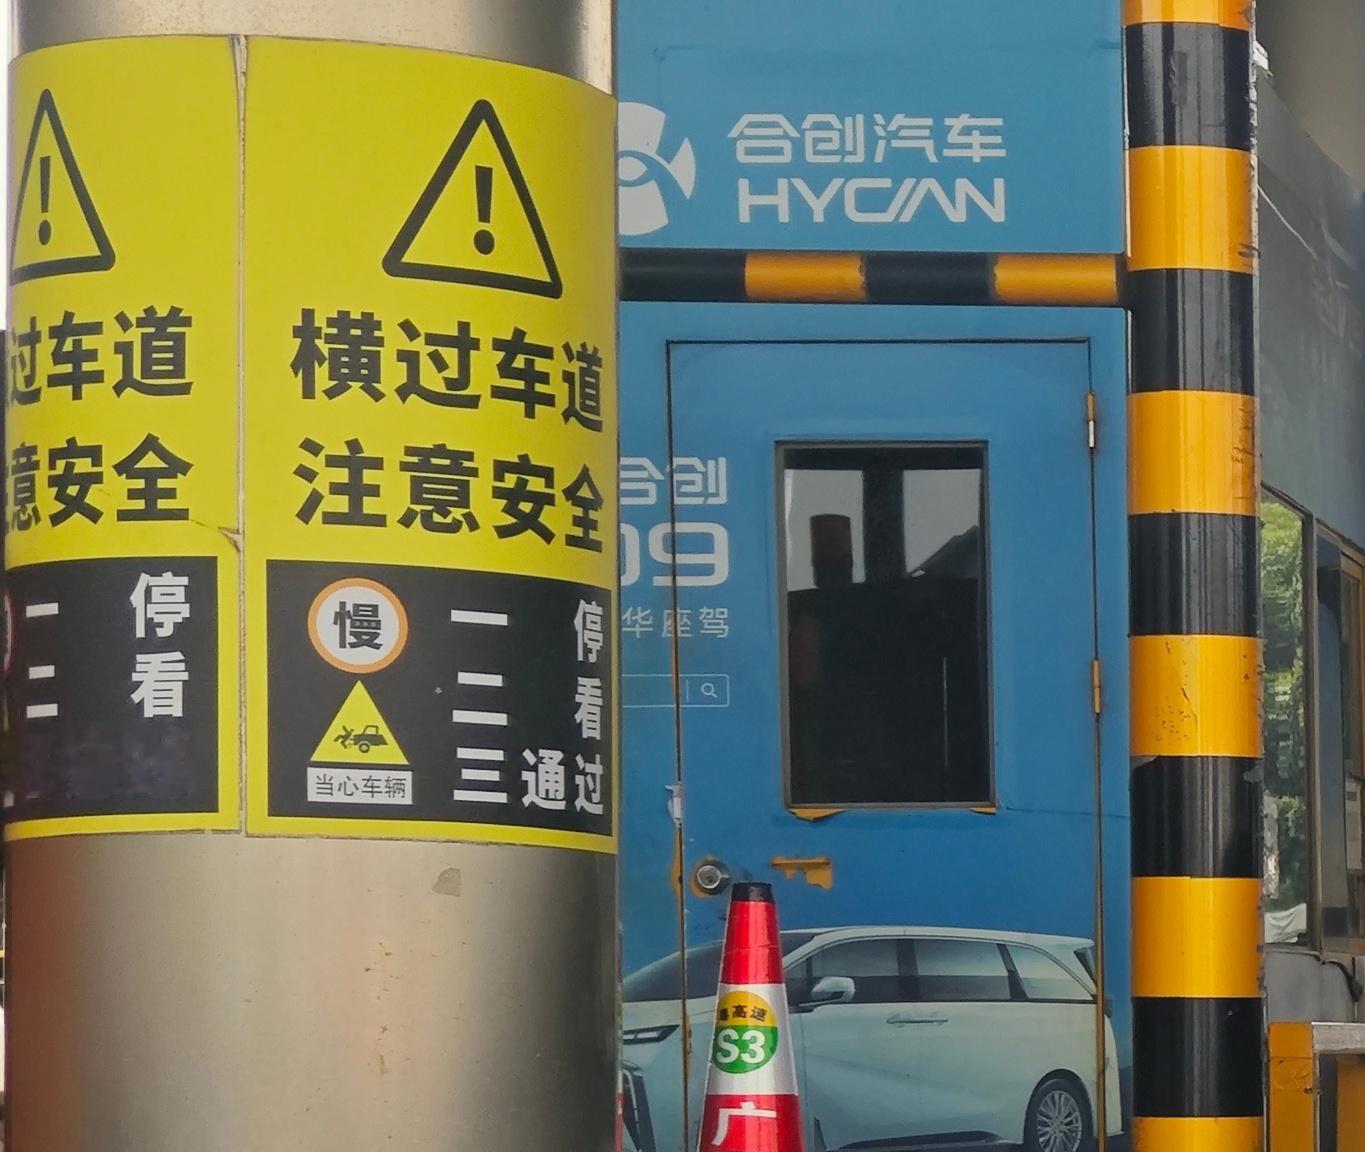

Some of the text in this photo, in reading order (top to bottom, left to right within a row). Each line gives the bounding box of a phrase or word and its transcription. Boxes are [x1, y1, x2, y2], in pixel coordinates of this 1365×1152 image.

[728, 113, 1006, 164] 合创汽车
[738, 177, 1006, 223] HYCAN
[291, 307, 604, 432] 横过车道
[292, 436, 604, 553] 注意安全
[620, 522, 729, 587] 9
[130, 572, 190, 639] 停
[333, 601, 382, 650] 慢
[574, 599, 604, 664] 停
[130, 651, 190, 719] 看
[574, 676, 604, 740] 看
[316, 773, 407, 799] 当心车辆
[521, 748, 604, 815] 通过
[716, 1028, 766, 1065] S3
